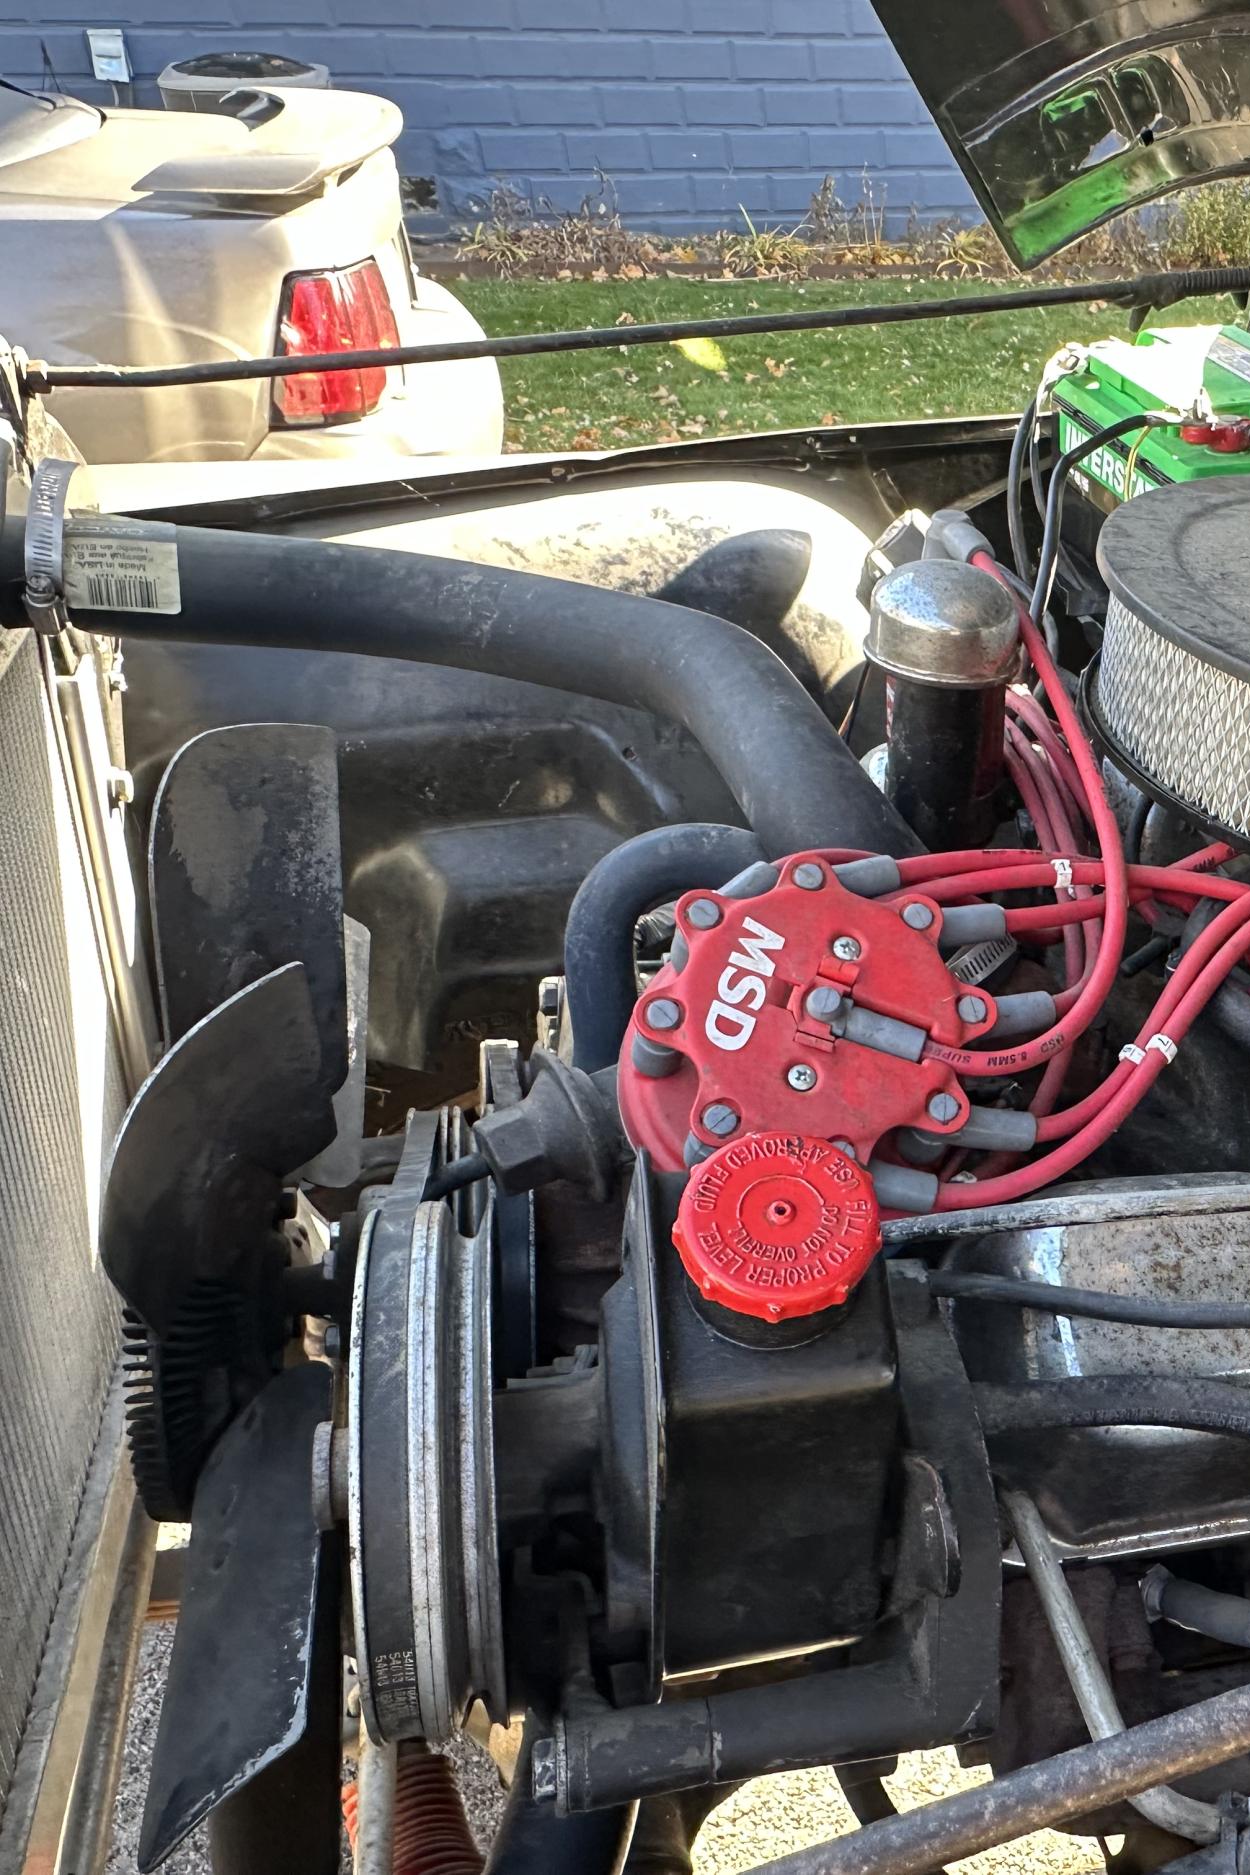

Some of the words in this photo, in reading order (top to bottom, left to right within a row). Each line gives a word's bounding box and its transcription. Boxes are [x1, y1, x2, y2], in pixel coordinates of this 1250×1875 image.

[705, 916, 786, 1051] MSD
[694, 1164, 732, 1211] FLUID
[824, 1157, 860, 1191] USE
[820, 1204, 839, 1225] DO
[841, 1200, 871, 1236] FILL
[697, 1222, 743, 1275] LEVEL
[800, 1227, 833, 1256] NOT
[827, 1242, 853, 1267] TO
[745, 1260, 827, 1287] PROPER
